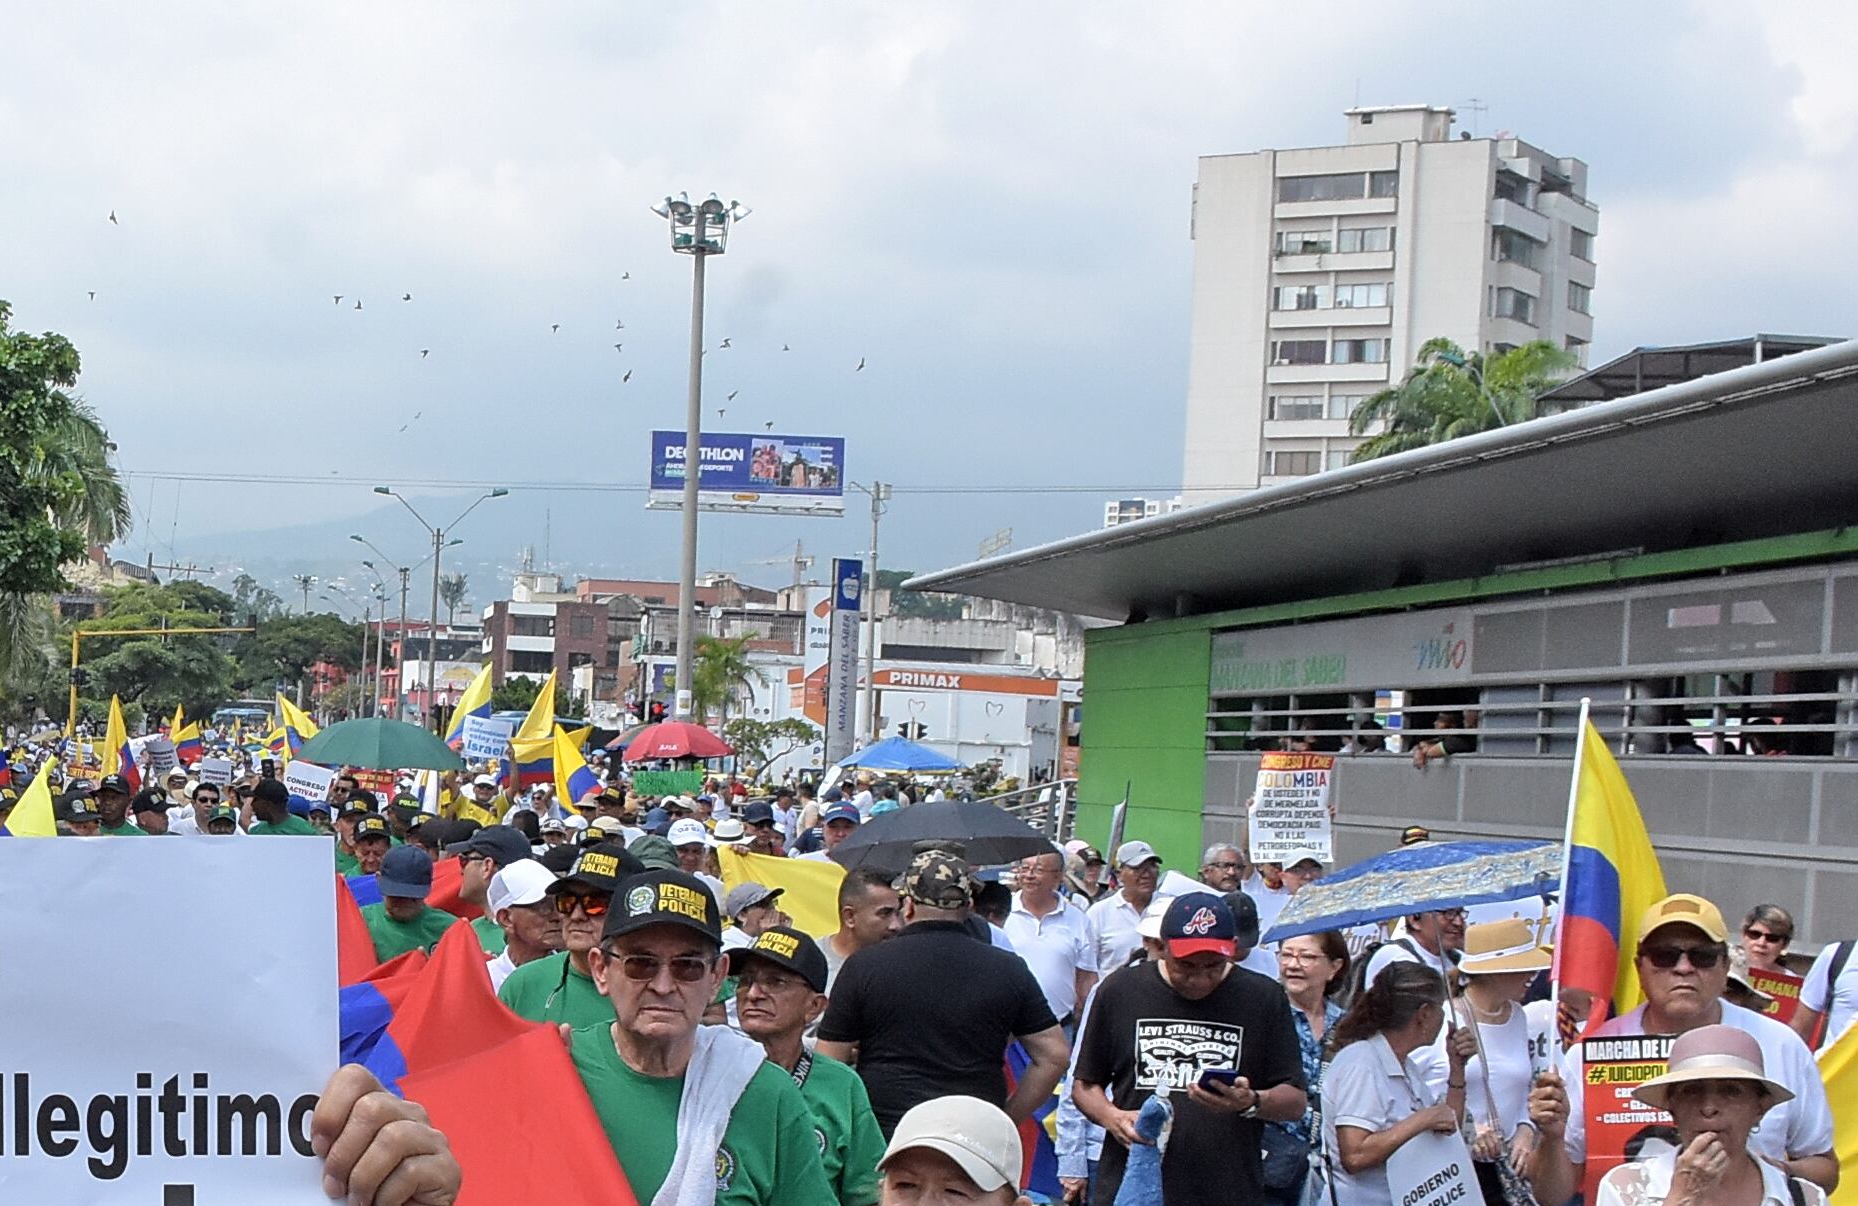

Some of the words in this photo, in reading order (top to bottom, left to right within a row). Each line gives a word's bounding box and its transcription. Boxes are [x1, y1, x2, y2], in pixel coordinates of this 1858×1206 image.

[665, 446, 744, 461] DETHLON
[889, 671, 961, 688] PRIMAX
[467, 740, 505, 757] Israel
[286, 776, 327, 791] CONGRESO
[1258, 772, 1327, 788] COLOMBIA
[289, 785, 319, 799] ACTIVAR
[1275, 800, 1319, 808] MERMELADA
[1256, 810, 1292, 818] CORRUPTA
[1258, 821, 1303, 829] DEMOCRACIA
[1258, 842, 1316, 850] PETROREFORMAS
[584, 852, 619, 867] VETERANO
[580, 862, 616, 878] POLICIA
[659, 883, 707, 909] VETERANO
[659, 899, 707, 924] POLICIA
[760, 931, 800, 950] VETERANO
[755, 942, 795, 960] POLICIA
[1139, 1026, 1162, 1036] LEVI
[1165, 1024, 1212, 1039] STRAUSS
[1213, 1030, 1222, 1040] &
[1586, 1040, 1641, 1061] MARCHA
[1642, 1038, 1659, 1059] DE
[791, 1056, 811, 1088] NIKE
[1603, 1112, 1657, 1124] COLECTIVOS
